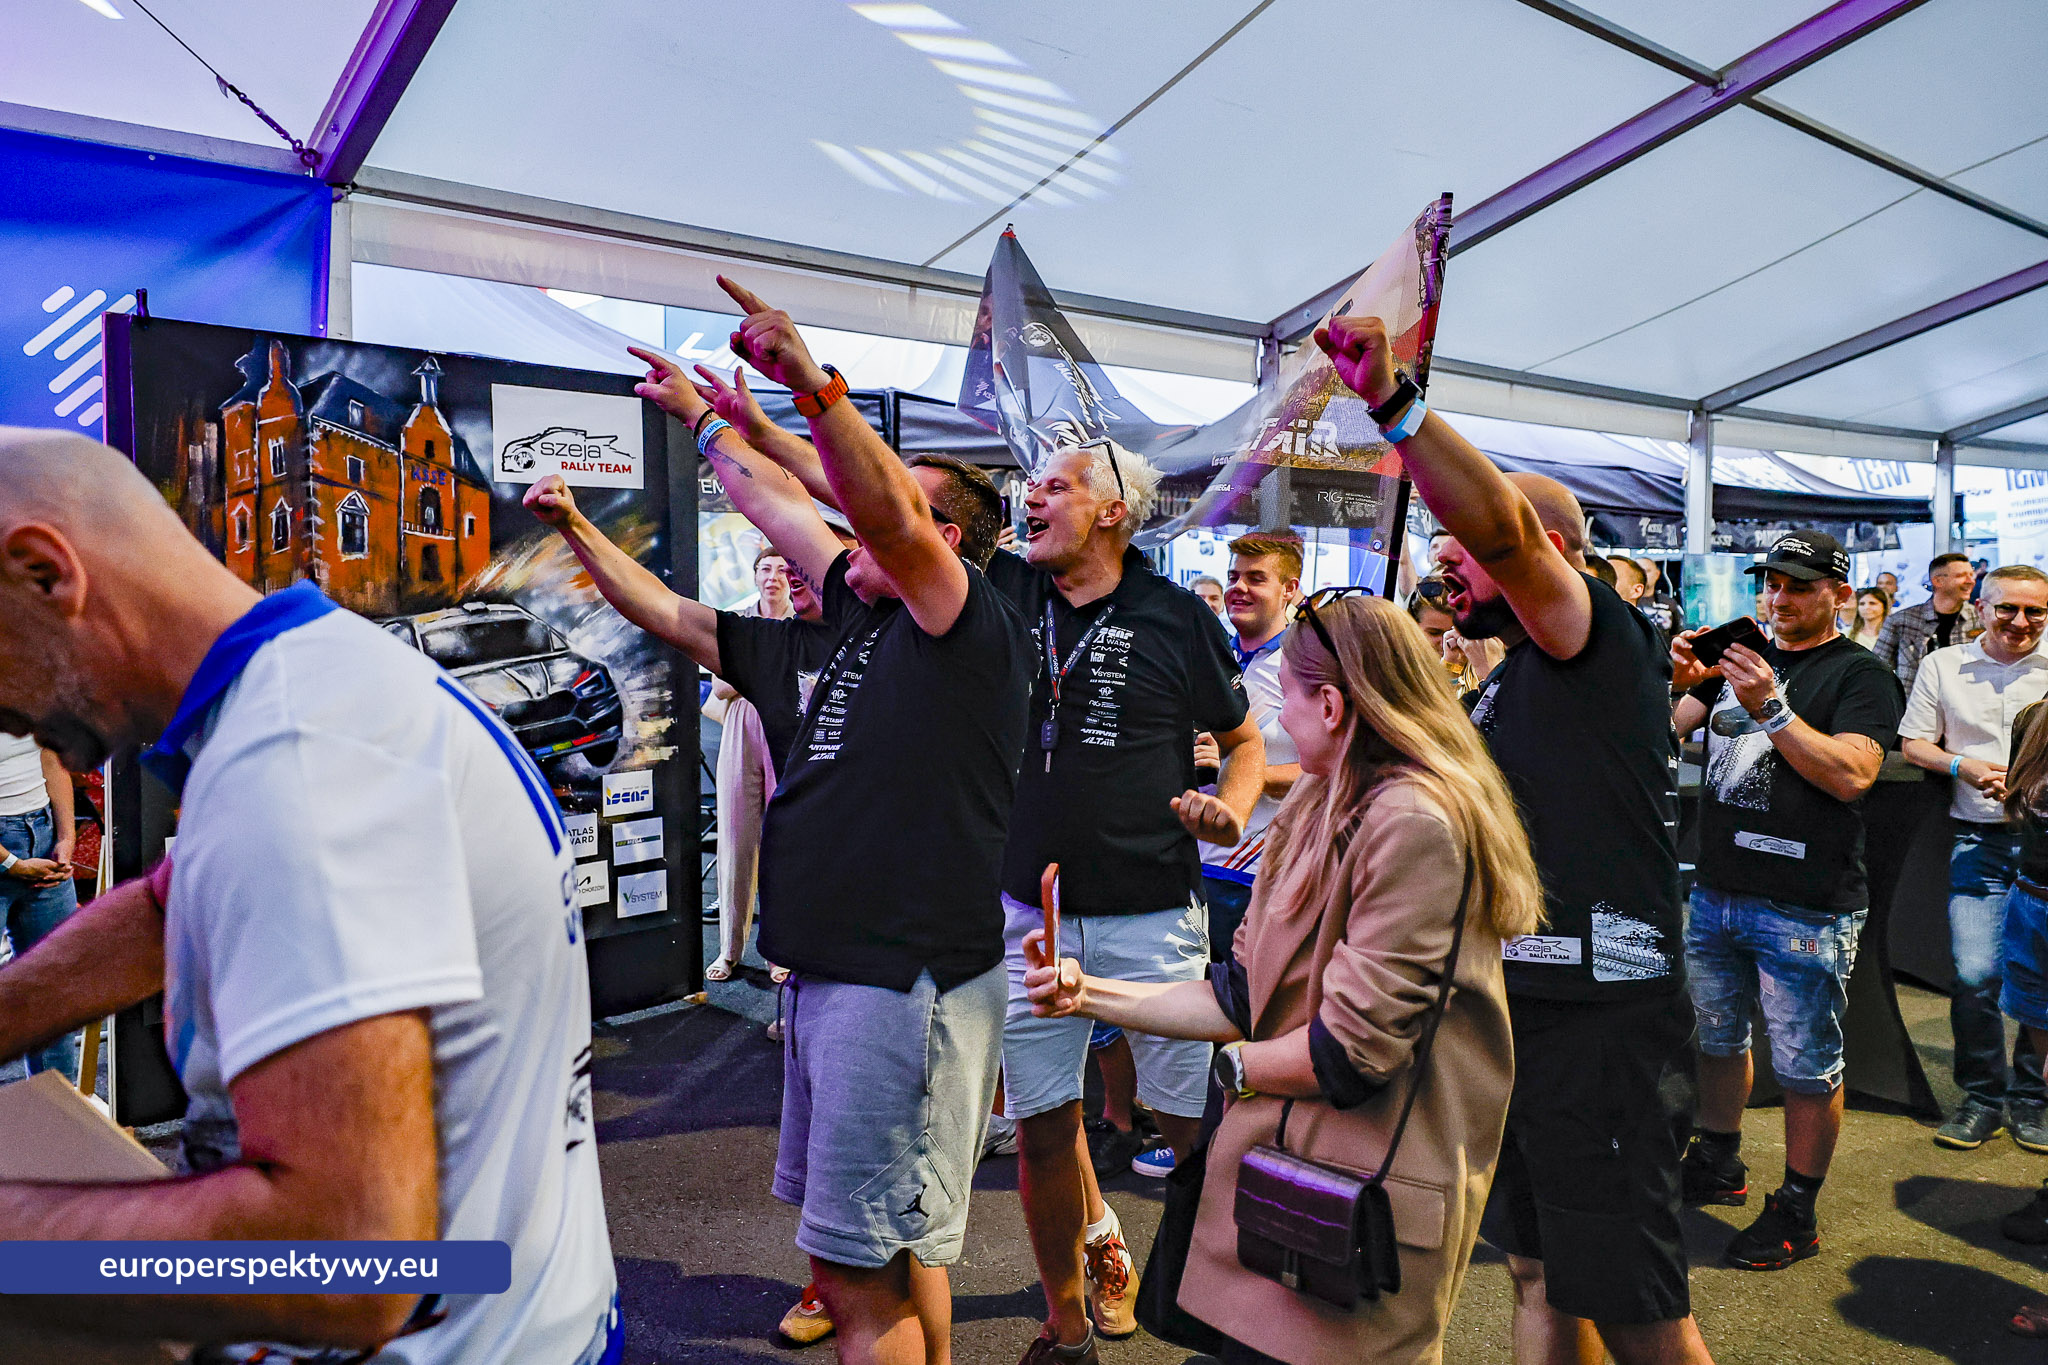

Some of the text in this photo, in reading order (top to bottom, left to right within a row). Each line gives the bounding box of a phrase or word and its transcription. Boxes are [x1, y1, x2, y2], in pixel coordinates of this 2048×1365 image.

[540, 439, 601, 462] szeja
[561, 460, 632, 474] RALLY TEAM
[412, 466, 448, 485] KSSE
[1317, 491, 1343, 503] RIG
